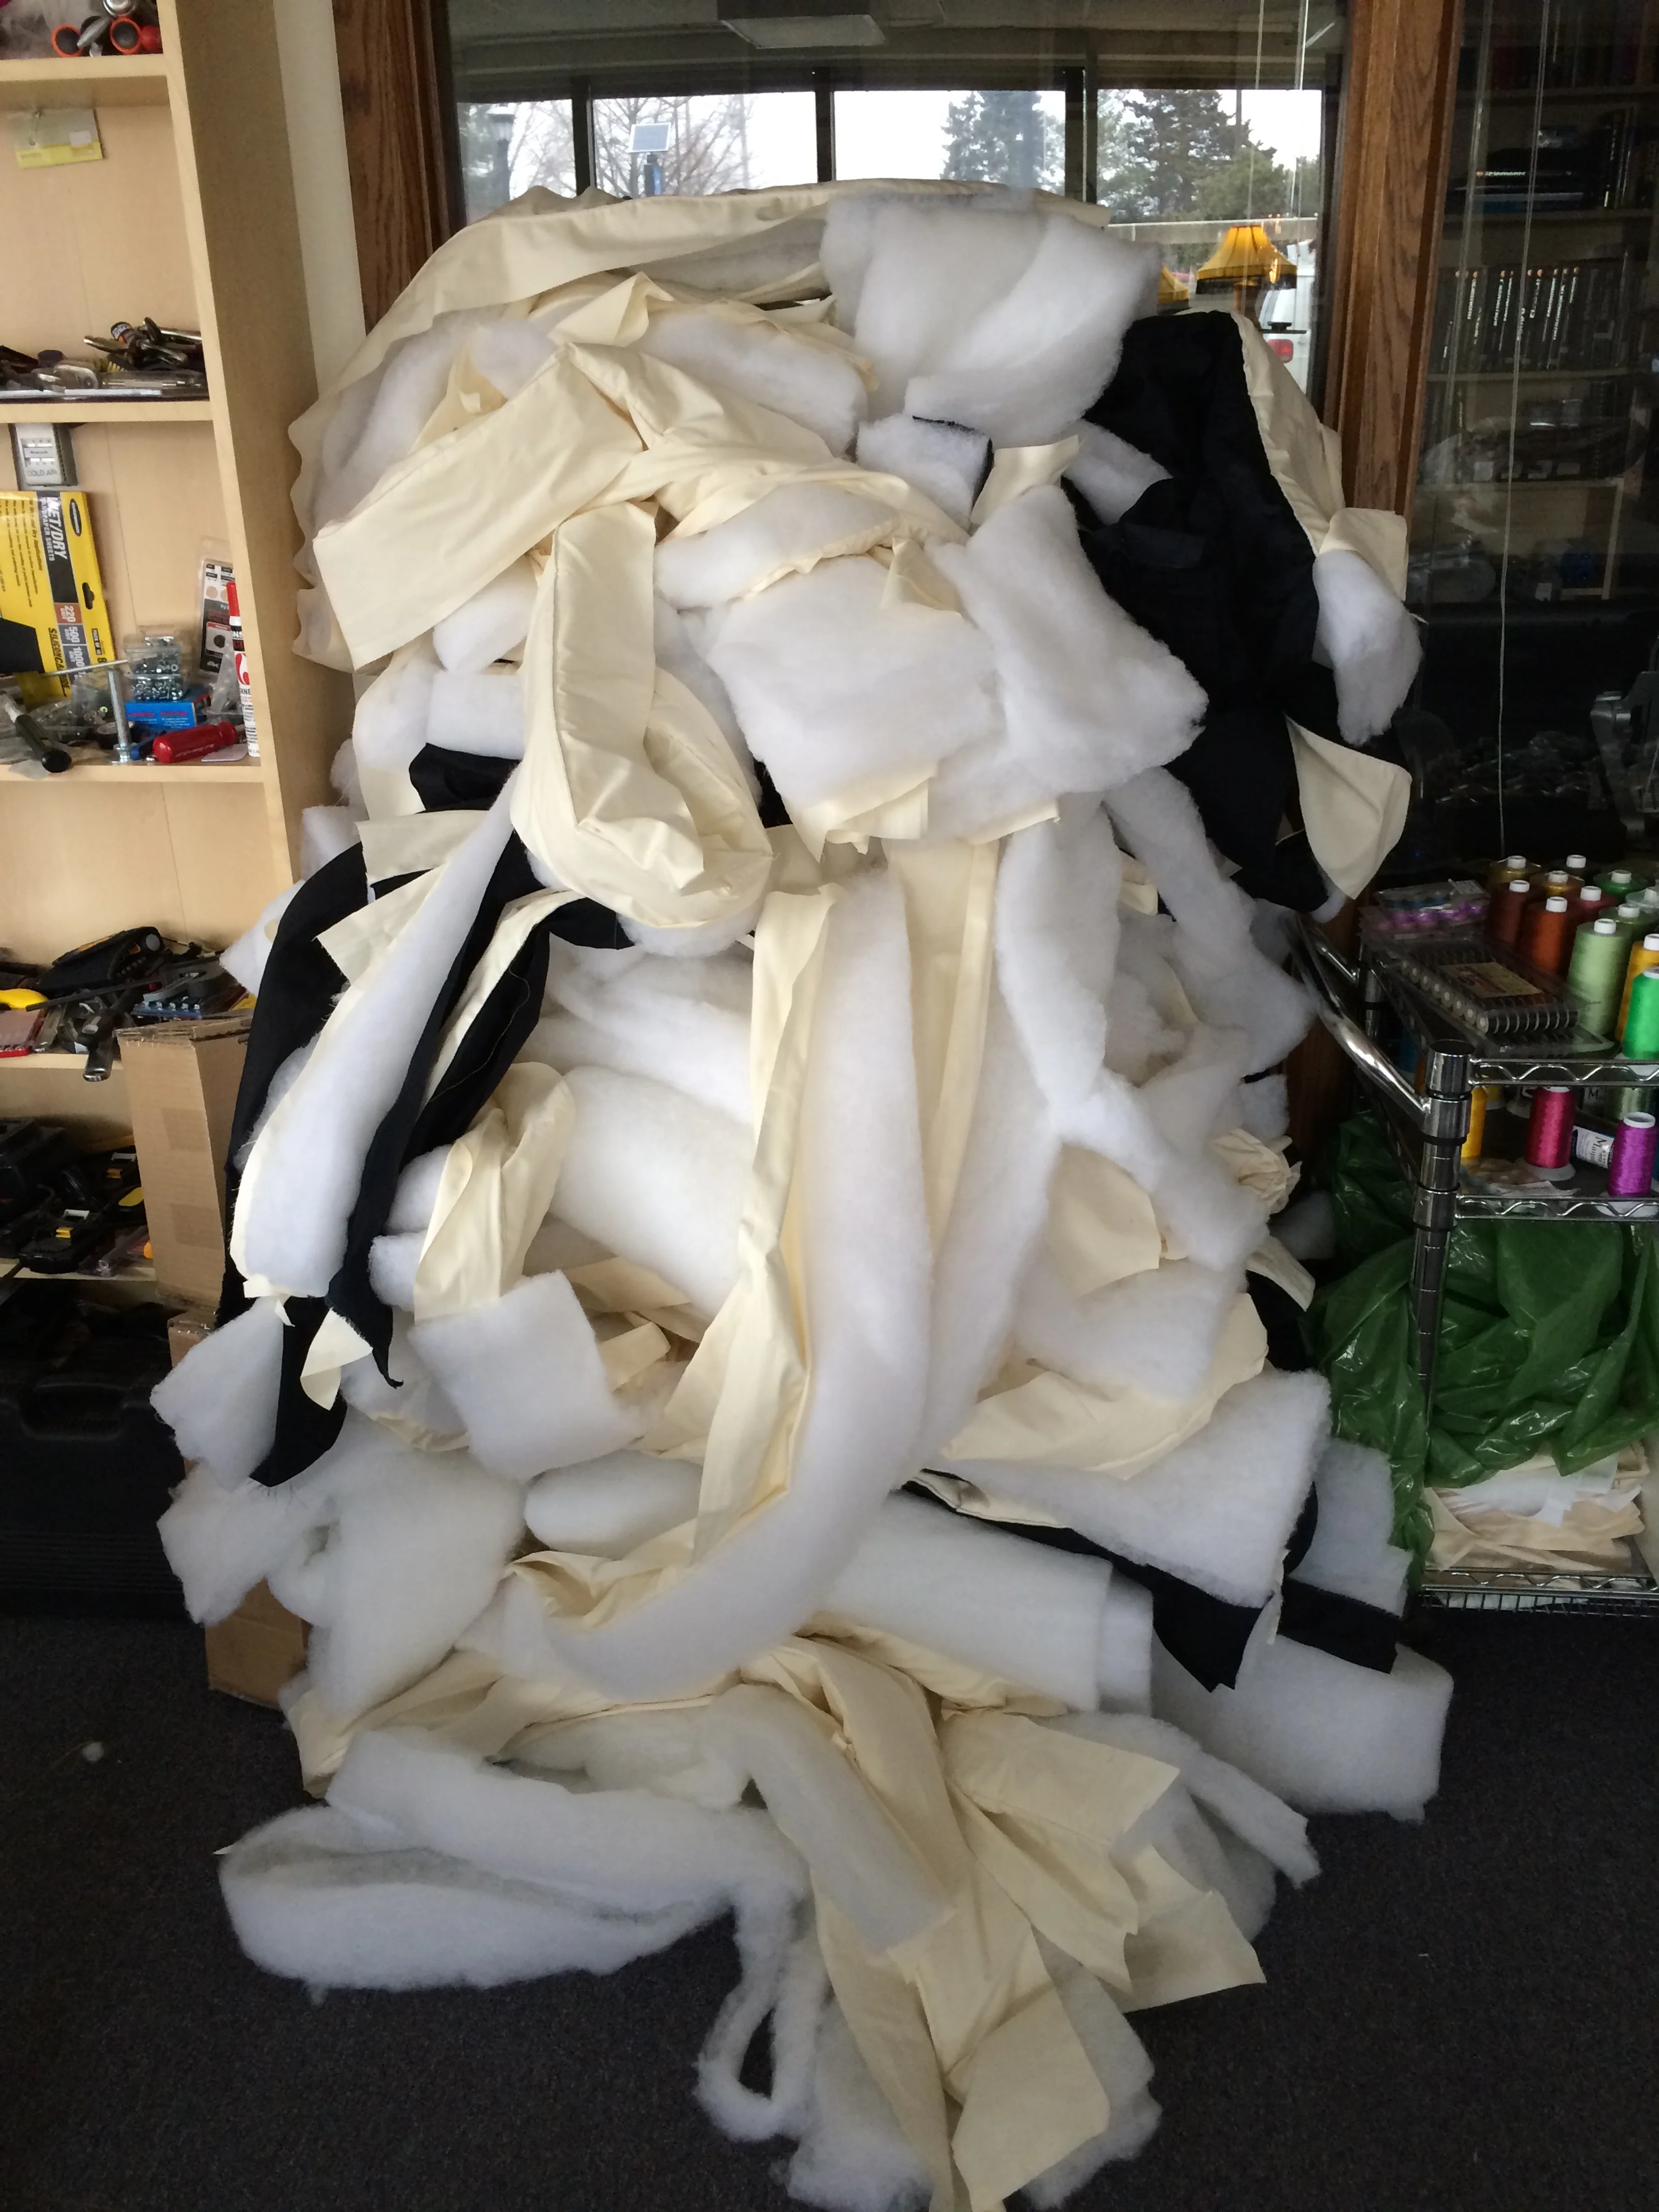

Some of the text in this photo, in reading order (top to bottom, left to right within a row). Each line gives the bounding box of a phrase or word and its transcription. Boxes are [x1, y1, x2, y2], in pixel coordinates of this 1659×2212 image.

[47, 497, 68, 560] WET/DRY
[45, 537, 55, 561] SHEETS
[65, 605, 76, 622] 220
[69, 626, 80, 643] 500
[73, 647, 85, 669] 1000
